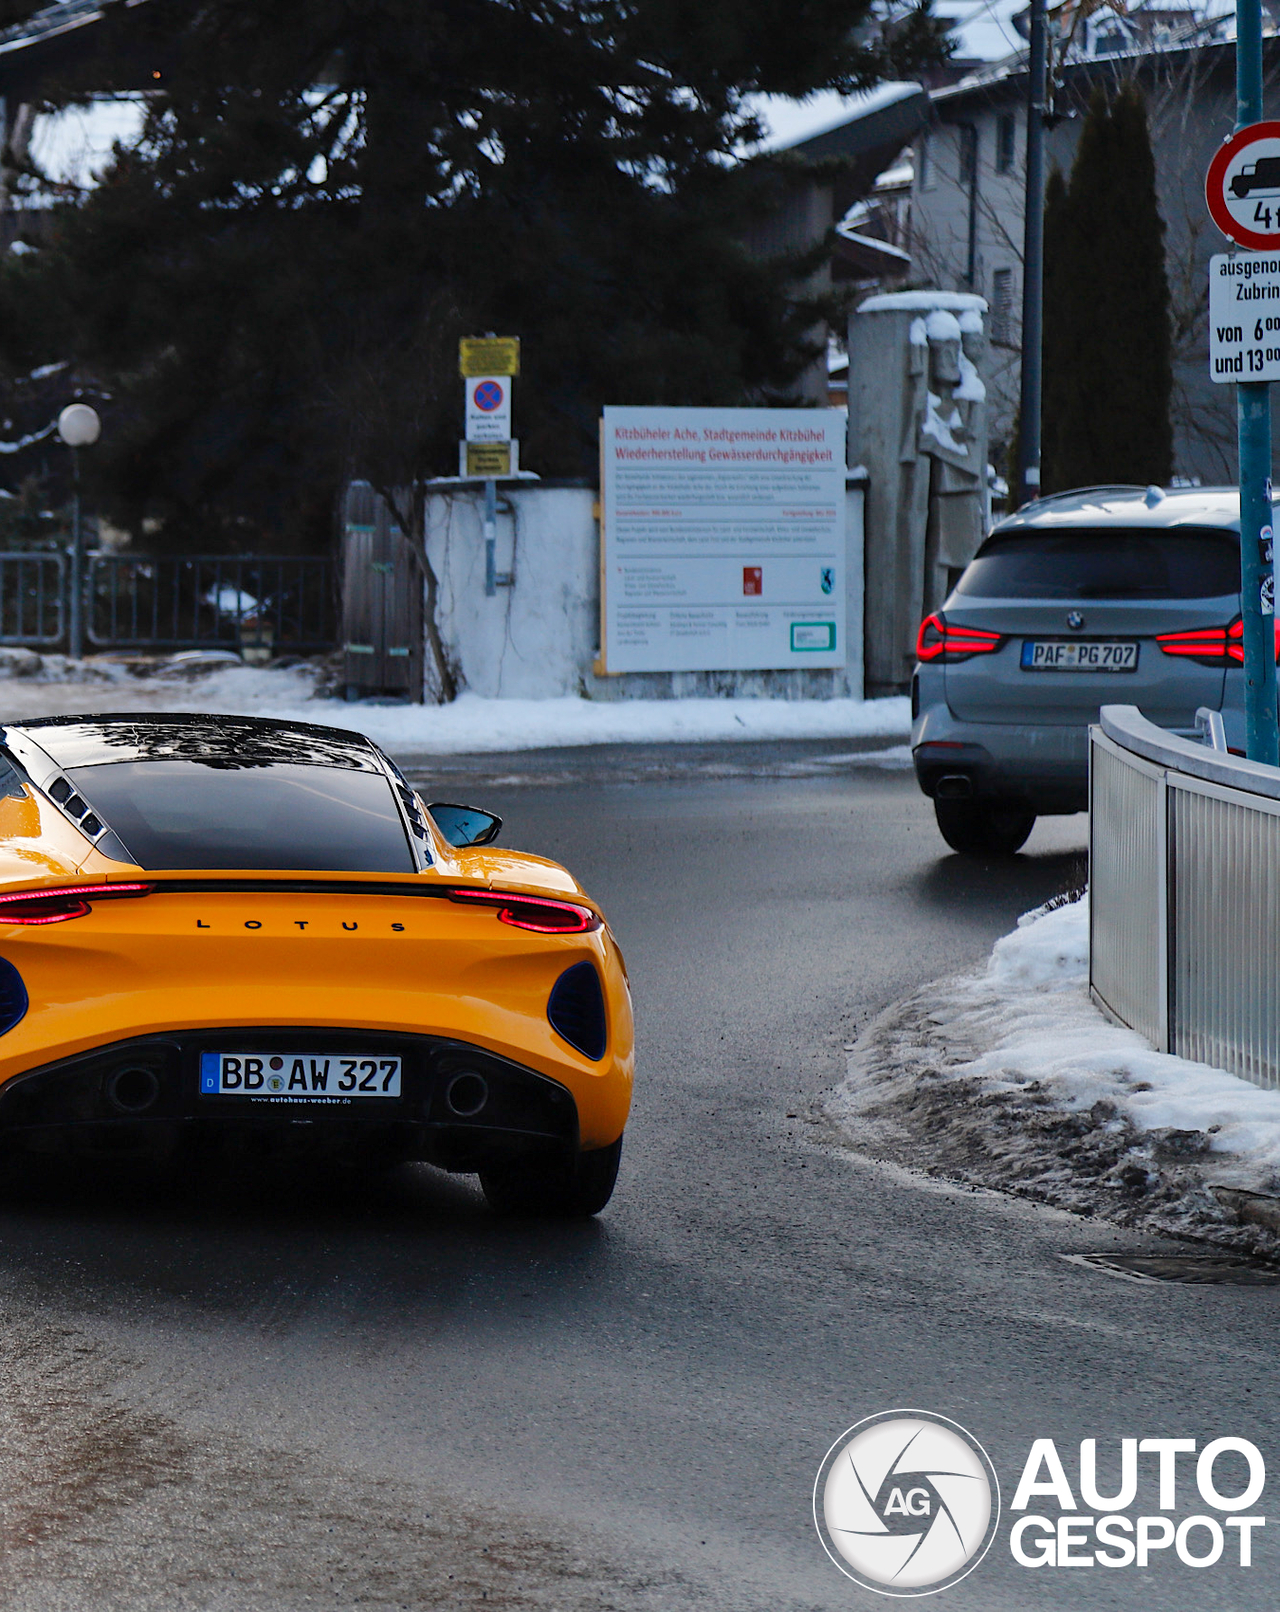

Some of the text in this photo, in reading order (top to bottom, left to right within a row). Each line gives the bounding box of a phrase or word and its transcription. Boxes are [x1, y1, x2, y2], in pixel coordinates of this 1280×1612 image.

[1219, 260, 1280, 279] ausgeno
[1236, 281, 1280, 301] Zubrin
[1216, 326, 1243, 343] von
[1215, 350, 1243, 373] und
[615, 426, 825, 444] Kitzbüheler Ache, Stadtgemeinde Kitzbühel
[615, 446, 833, 465] Wiederherstellung Gewässerdurchgängigkeit
[1035, 645, 1134, 665] PAF PG 707
[196, 919, 405, 932] LOTUS
[206, 1078, 215, 1088] D
[222, 1057, 399, 1092] BB AW 327
[250, 1096, 352, 1105] www.autohaus-weeber.de
